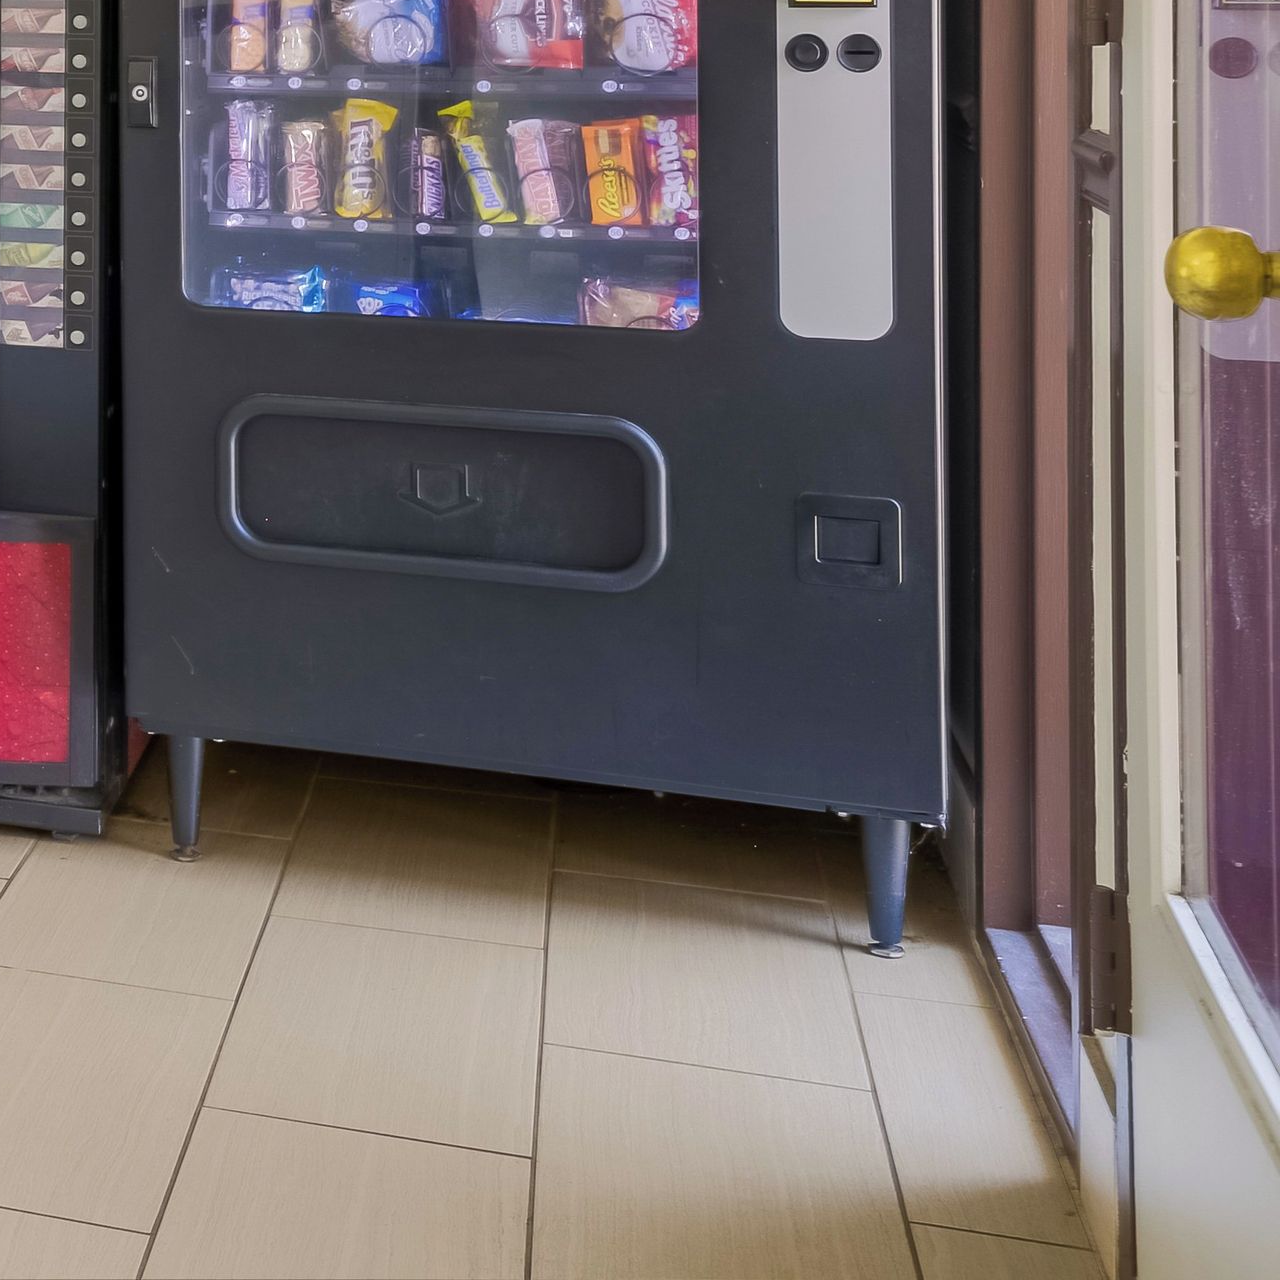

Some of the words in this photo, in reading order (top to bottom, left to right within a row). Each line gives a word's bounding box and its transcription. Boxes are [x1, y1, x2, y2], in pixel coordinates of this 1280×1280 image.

[293, 141, 321, 210] TWIX
[425, 158, 445, 218] SNICKERS
[461, 144, 501, 209] Butterfinger
[598, 157, 622, 217] Reese's
[657, 119, 691, 209] Skittles
